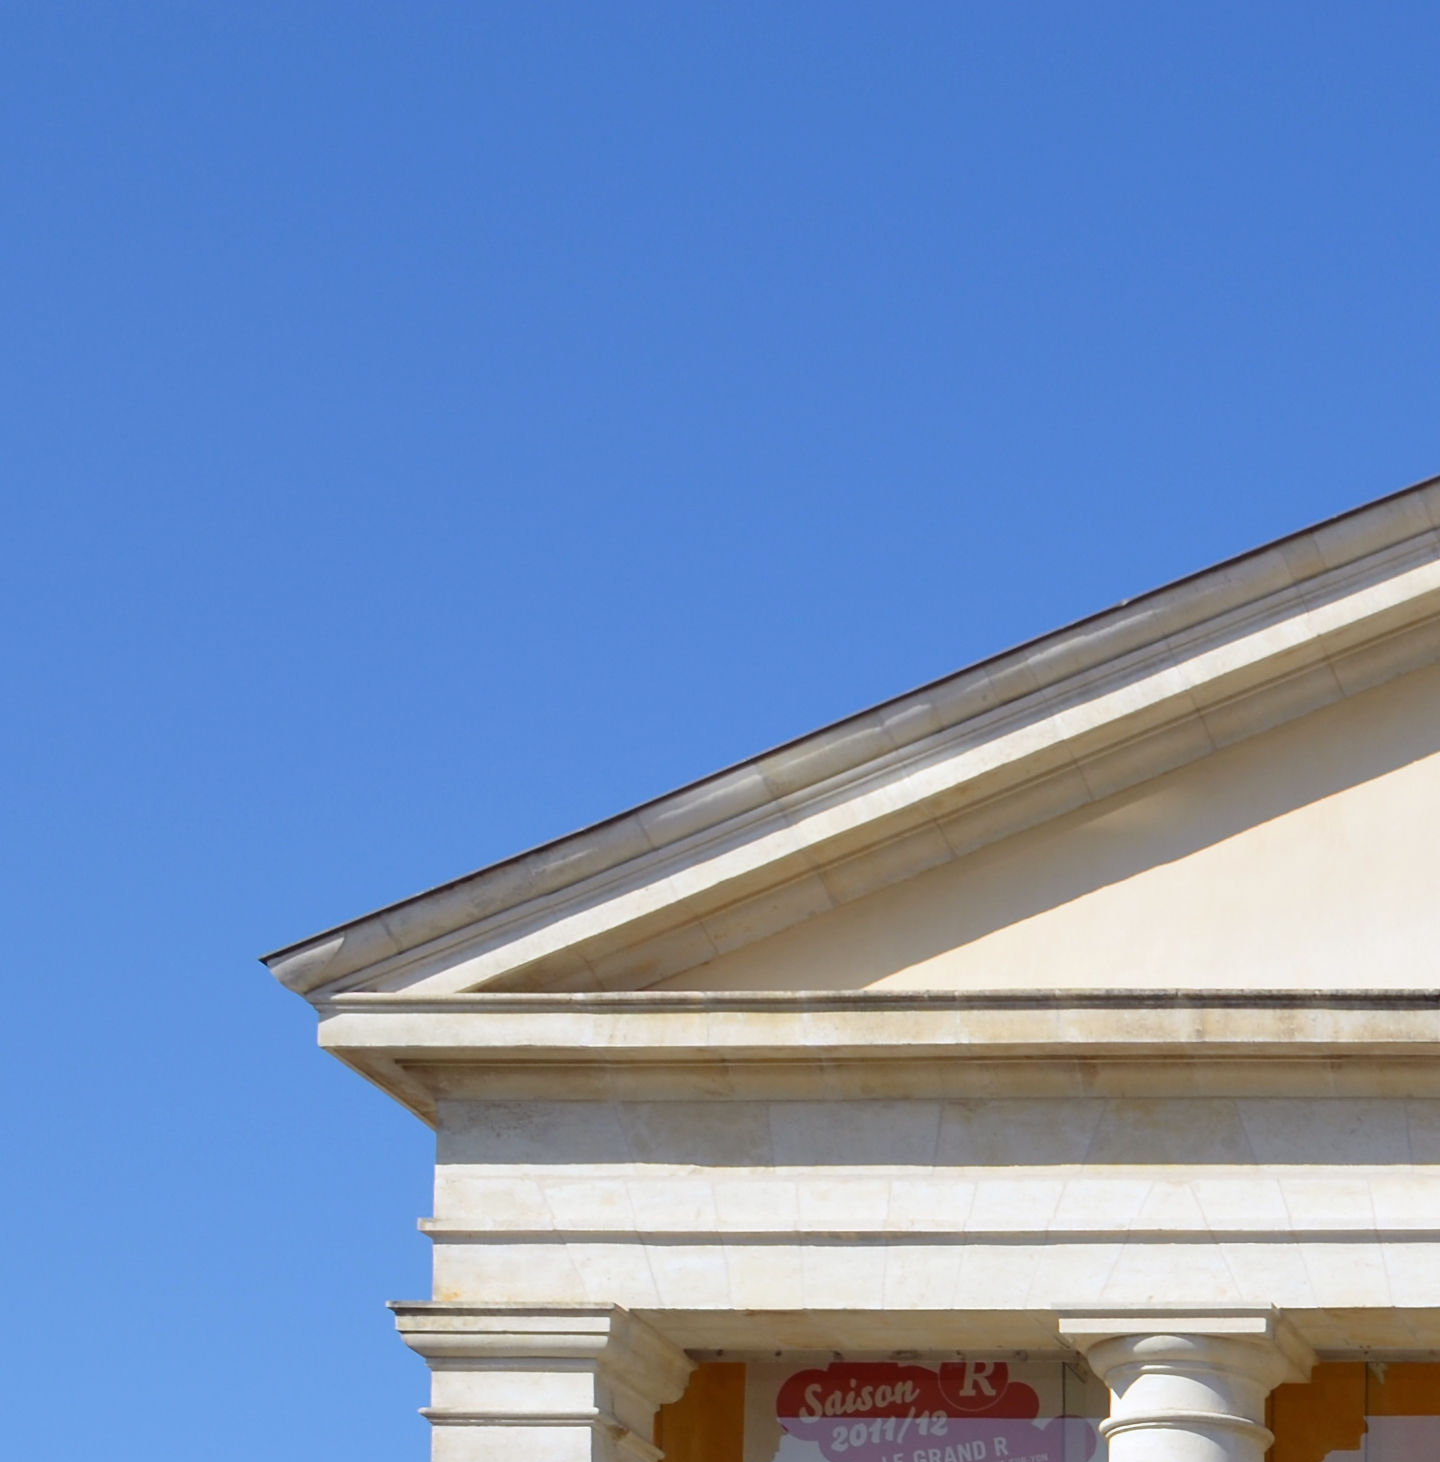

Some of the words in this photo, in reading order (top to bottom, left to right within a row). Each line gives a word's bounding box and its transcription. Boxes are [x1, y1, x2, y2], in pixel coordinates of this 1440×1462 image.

[960, 1361, 996, 1397] R
[799, 1378, 920, 1424] Saison
[830, 1406, 948, 1452] 2011/12
[994, 1436, 1009, 1456] R
